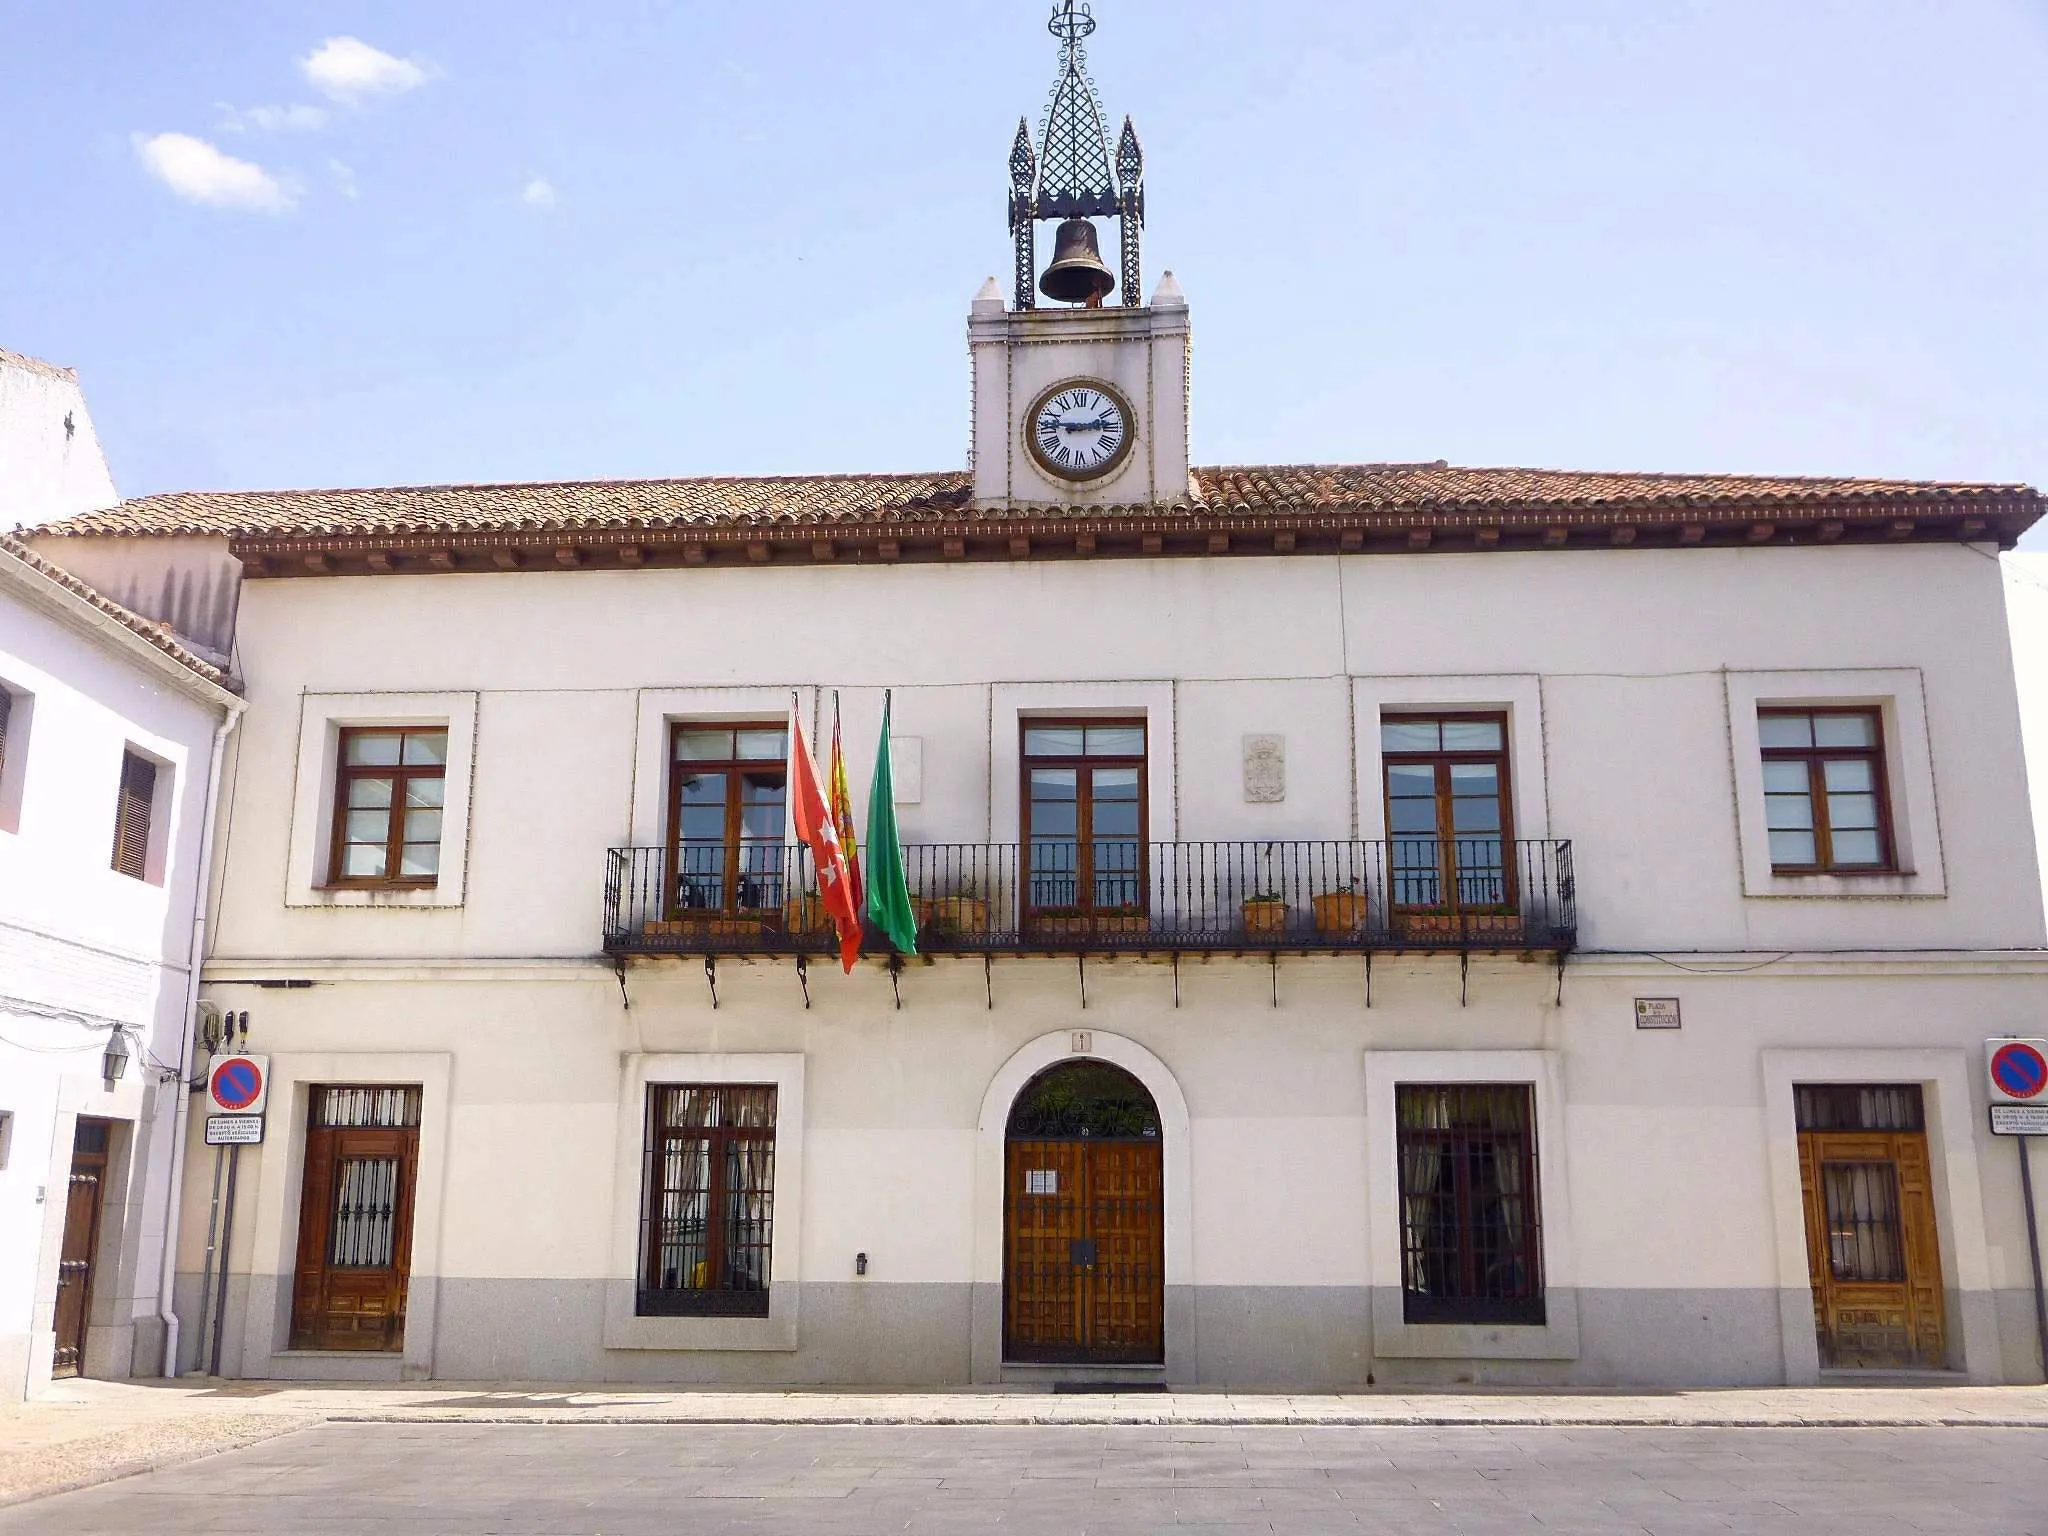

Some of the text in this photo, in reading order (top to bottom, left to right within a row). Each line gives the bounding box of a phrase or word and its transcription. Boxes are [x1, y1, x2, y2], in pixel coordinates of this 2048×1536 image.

[1054, 396, 1072, 413] XI
[1072, 392, 1088, 408] XII
[1090, 396, 1100, 411] I
[1044, 408, 1062, 421] X
[1098, 407, 1115, 419] II
[1102, 421, 1119, 433] III
[1042, 434, 1061, 455] VIII
[1097, 434, 1118, 452] IIII
[1055, 446, 1071, 464] VII
[1074, 450, 1087, 465] VI
[1091, 447, 1102, 461] V
[1648, 1002, 1666, 1010] PLAZA
